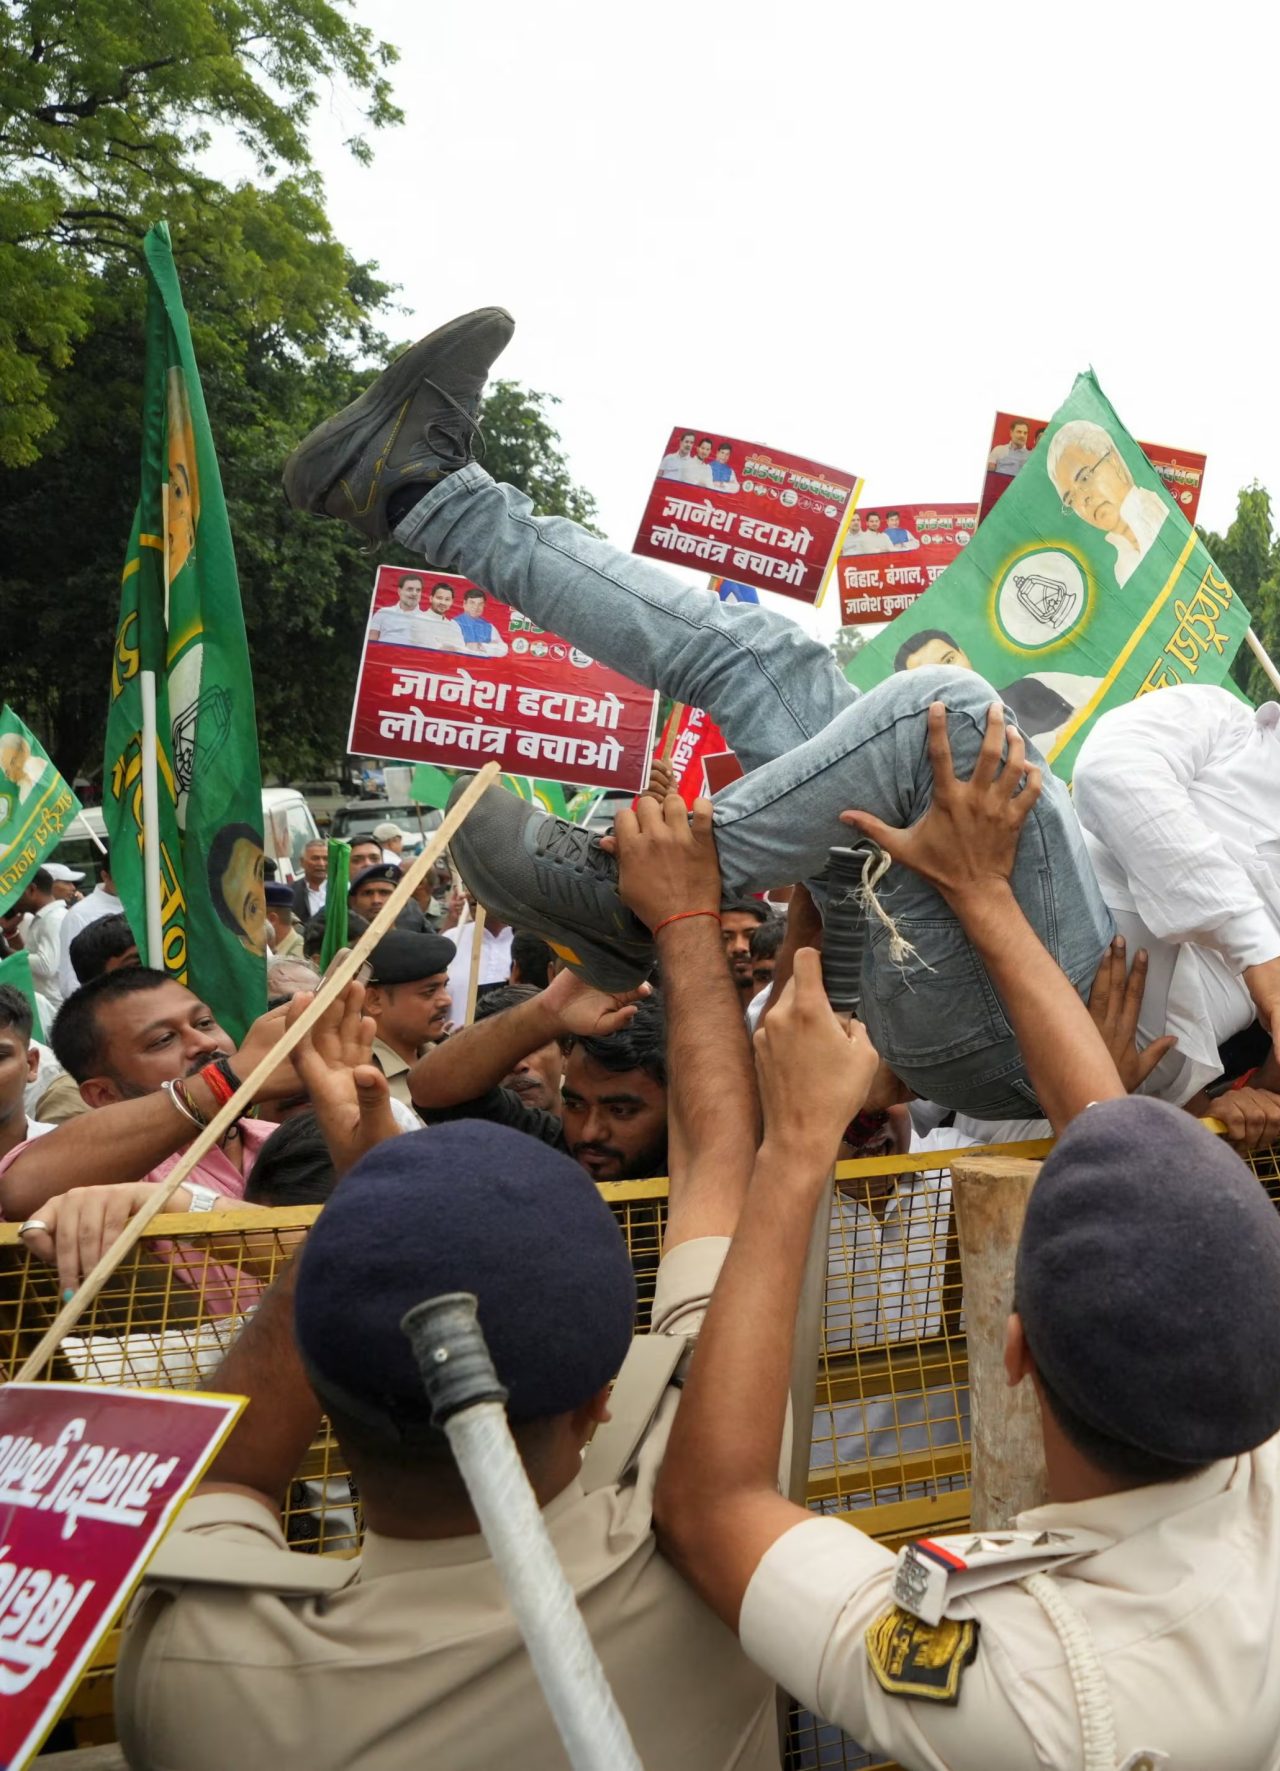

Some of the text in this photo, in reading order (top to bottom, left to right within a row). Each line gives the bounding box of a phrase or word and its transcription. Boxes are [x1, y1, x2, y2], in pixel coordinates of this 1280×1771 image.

[650, 523, 808, 586] लोकतंत्र बचाओ
[662, 496, 814, 555] ज्ञानेश हटाओ
[844, 566, 883, 589] बिहार,
[884, 564, 925, 585] बंगाल,
[845, 593, 882, 614] ज्ञानेश
[391, 668, 624, 729] ज्ञानेश हटाओ
[378, 706, 624, 771] लोकतंत्र बचाओ
